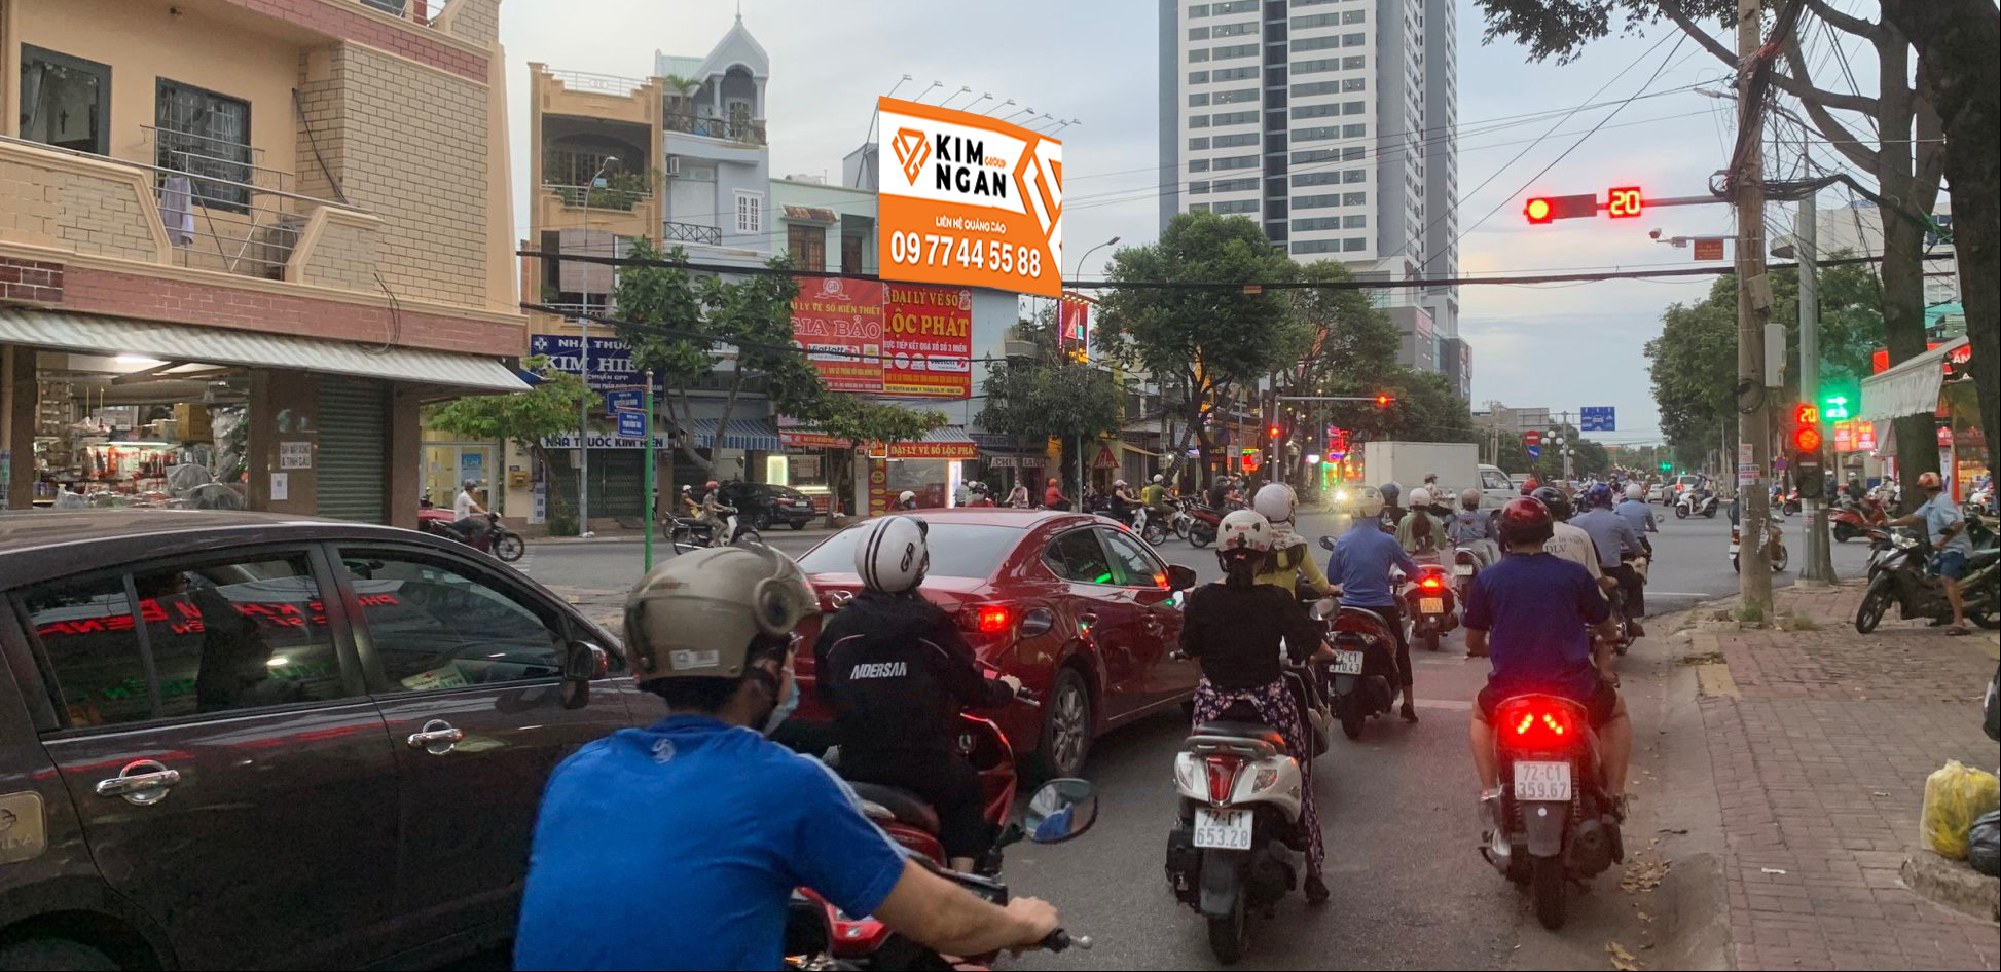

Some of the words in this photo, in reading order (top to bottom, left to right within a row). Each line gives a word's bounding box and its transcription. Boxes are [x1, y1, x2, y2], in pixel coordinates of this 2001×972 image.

[936, 134, 984, 166] KIM
[984, 156, 1006, 168] GROUP
[1610, 189, 1641, 215] 20
[936, 215, 952, 228] LIÊN
[891, 230, 921, 264] 09
[924, 234, 954, 267] 77
[956, 237, 984, 269] 44
[989, 240, 1013, 273] 55
[1017, 246, 1041, 278] 88
[892, 289, 911, 306] ĐẠI
[914, 289, 926, 305] LÝ
[945, 290, 959, 307] SỐ
[833, 314, 881, 339] BẢO
[884, 307, 917, 338] LỘC
[920, 311, 969, 337] PHÁT
[542, 356, 590, 372] KIM
[1801, 408, 1817, 422] 20
[957, 445, 976, 455] PHÁ
[1522, 765, 1562, 781] 72-C1
[1518, 782, 1567, 798] 359.67
[1196, 828, 1248, 848] 653.28
